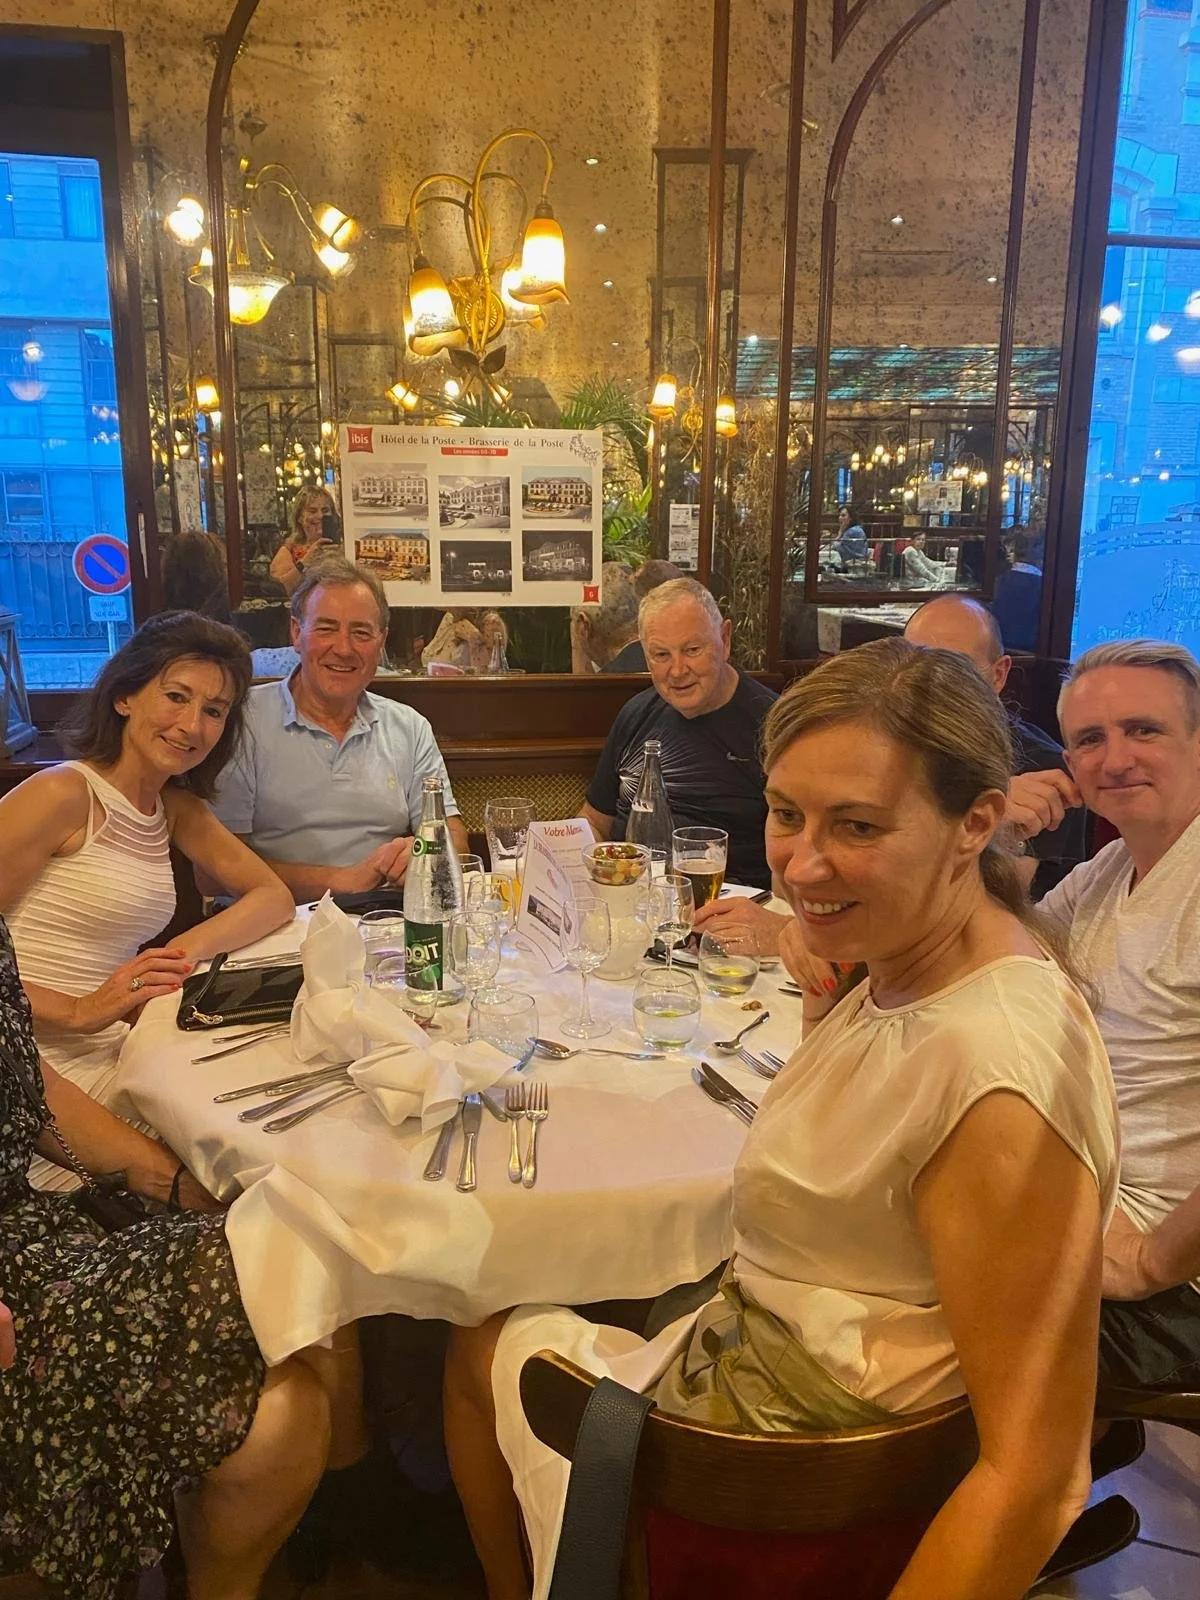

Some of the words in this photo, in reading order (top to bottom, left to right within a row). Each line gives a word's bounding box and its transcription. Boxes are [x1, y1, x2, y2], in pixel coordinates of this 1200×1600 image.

[351, 433, 369, 444] ibis
[381, 434, 405, 443] Hôtel
[407, 435, 419, 444] de
[421, 435, 429, 444] la
[432, 435, 456, 445] Poste
[469, 437, 510, 447] Brasserie
[514, 438, 524, 447] de
[528, 438, 537, 447] la
[540, 438, 564, 448] Poste
[543, 826, 565, 837] Votre
[405, 942, 439, 964] DOIT
